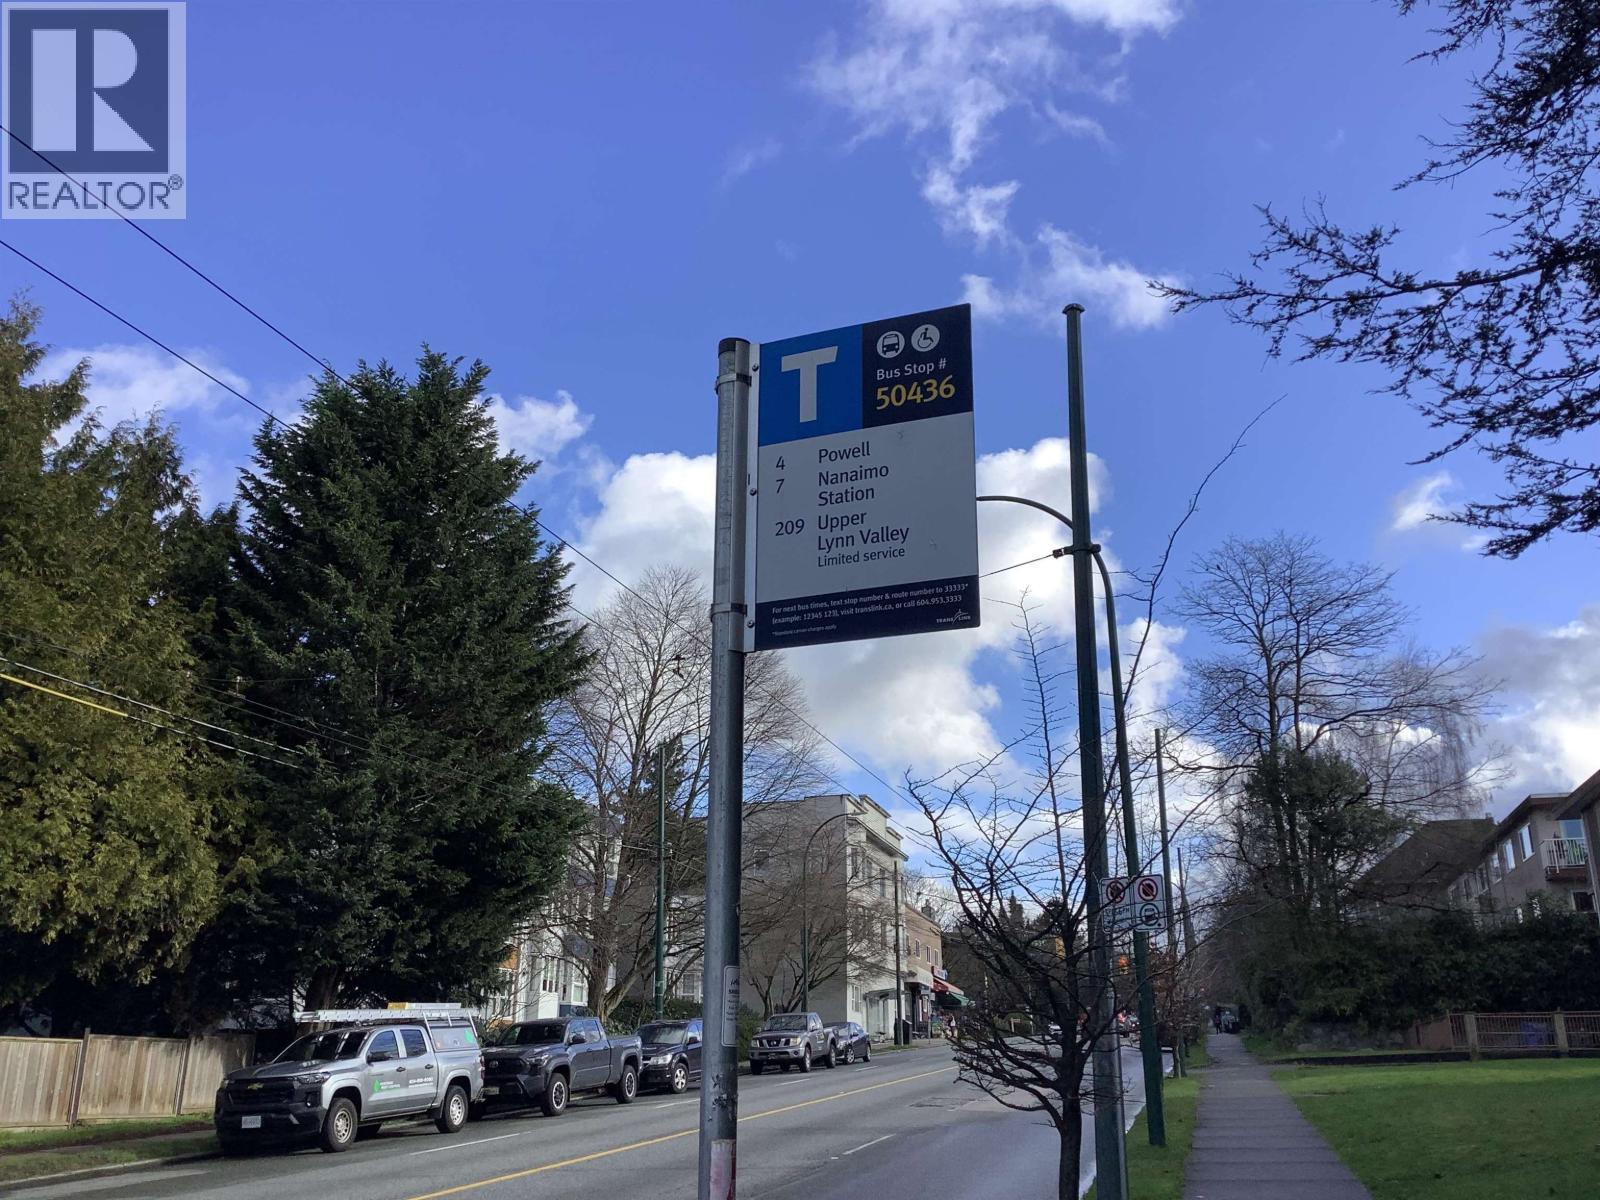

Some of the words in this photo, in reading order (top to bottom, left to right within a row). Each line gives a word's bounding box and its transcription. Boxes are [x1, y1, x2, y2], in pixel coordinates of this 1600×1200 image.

[876, 368, 901, 381] Bus
[904, 361, 935, 375] Stop
[938, 357, 948, 371] #
[781, 346, 838, 423] T
[875, 375, 956, 410] 50436
[775, 456, 786, 470] 4
[818, 441, 871, 464] Powell
[776, 479, 785, 494] 7
[818, 465, 889, 487] Nanaimo
[818, 486, 875, 507] Station
[775, 519, 805, 536] 209
[818, 512, 867, 533] Upper
[818, 533, 855, 553] Lynn
[860, 526, 910, 545] Valley
[818, 549, 860, 567] Limited
[864, 546, 906, 562] service
[803, 612, 823, 620] 12345
[916, 594, 962, 607] 604.953.3333
[844, 597, 858, 605] stop
[859, 594, 884, 602] number
[891, 591, 908, 599] route
[909, 588, 935, 597] number
